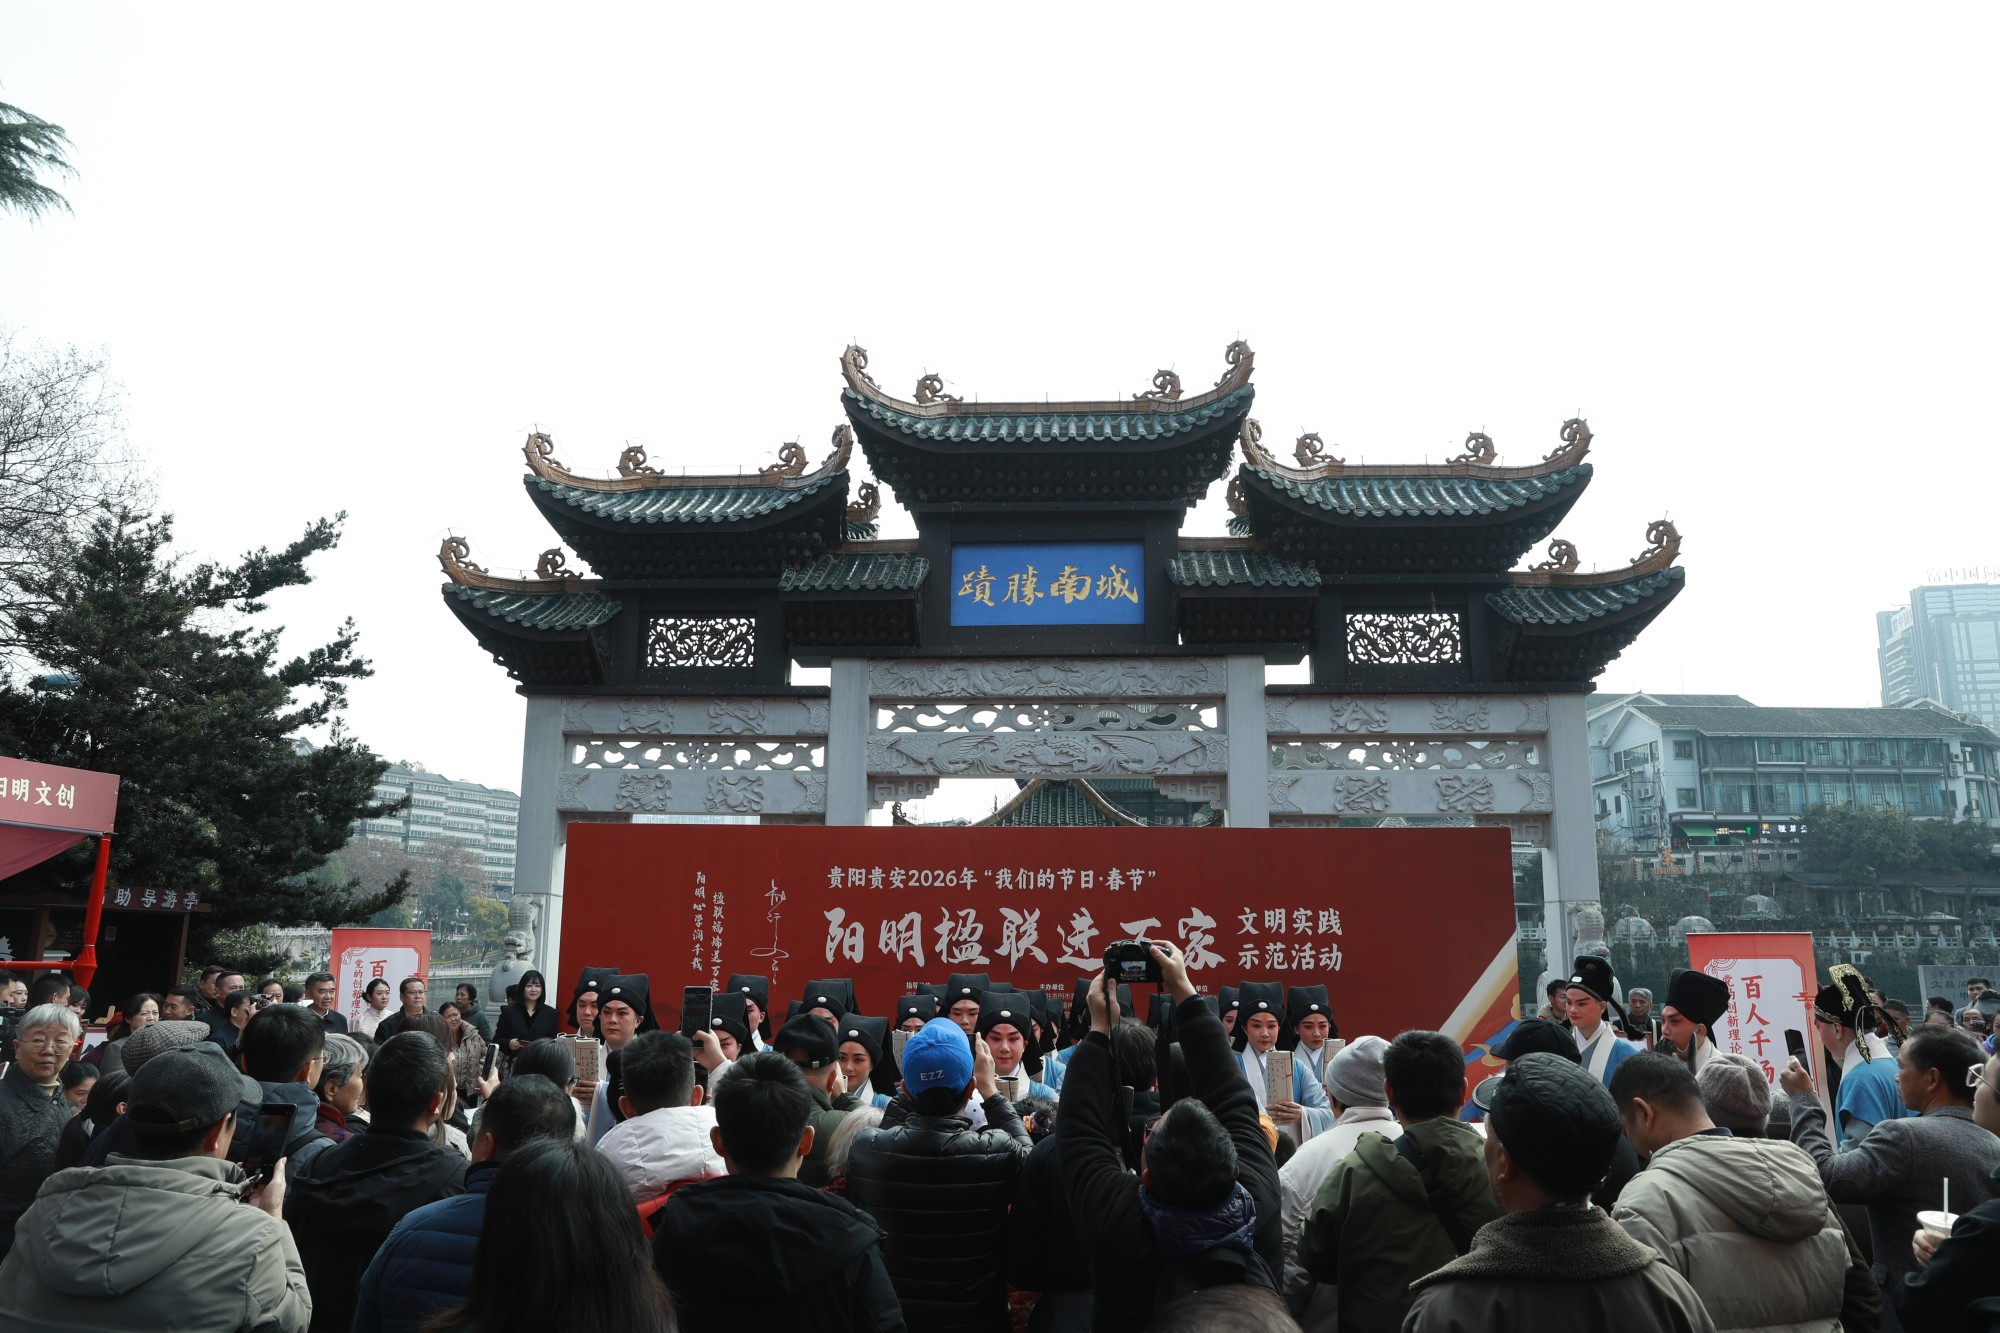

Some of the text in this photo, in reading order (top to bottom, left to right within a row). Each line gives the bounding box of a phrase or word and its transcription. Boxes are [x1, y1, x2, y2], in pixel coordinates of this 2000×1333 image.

[102, 888, 198, 910] 助导游亭
[1237, 907, 1343, 936] 文明实践
[1238, 942, 1343, 971] 示范活动
[370, 960, 387, 977] 百
[920, 1070, 944, 1080] EZZ
